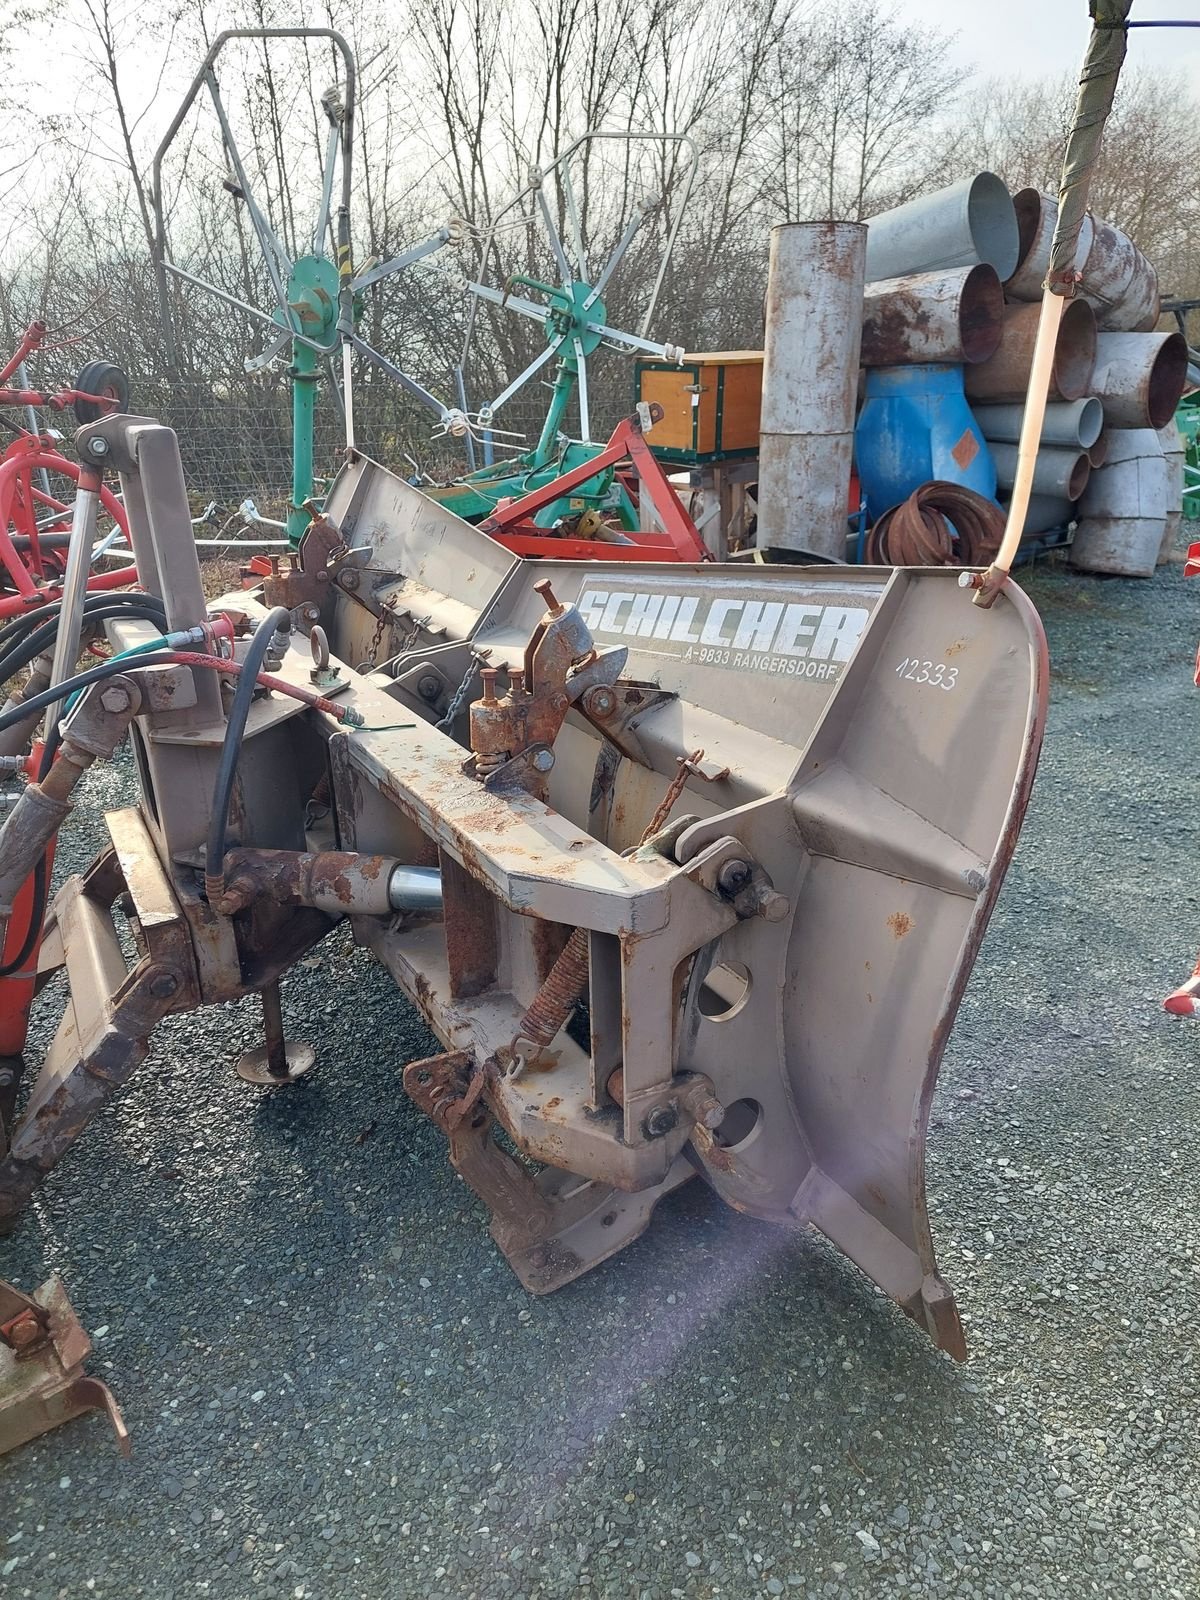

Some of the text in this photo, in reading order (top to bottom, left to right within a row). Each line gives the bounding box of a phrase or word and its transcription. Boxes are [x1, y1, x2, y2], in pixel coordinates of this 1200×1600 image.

[578, 590, 870, 663] SCHILCHER
[684, 646, 838, 680] A-9833 RANGERSDORF
[895, 657, 959, 691] 12333
